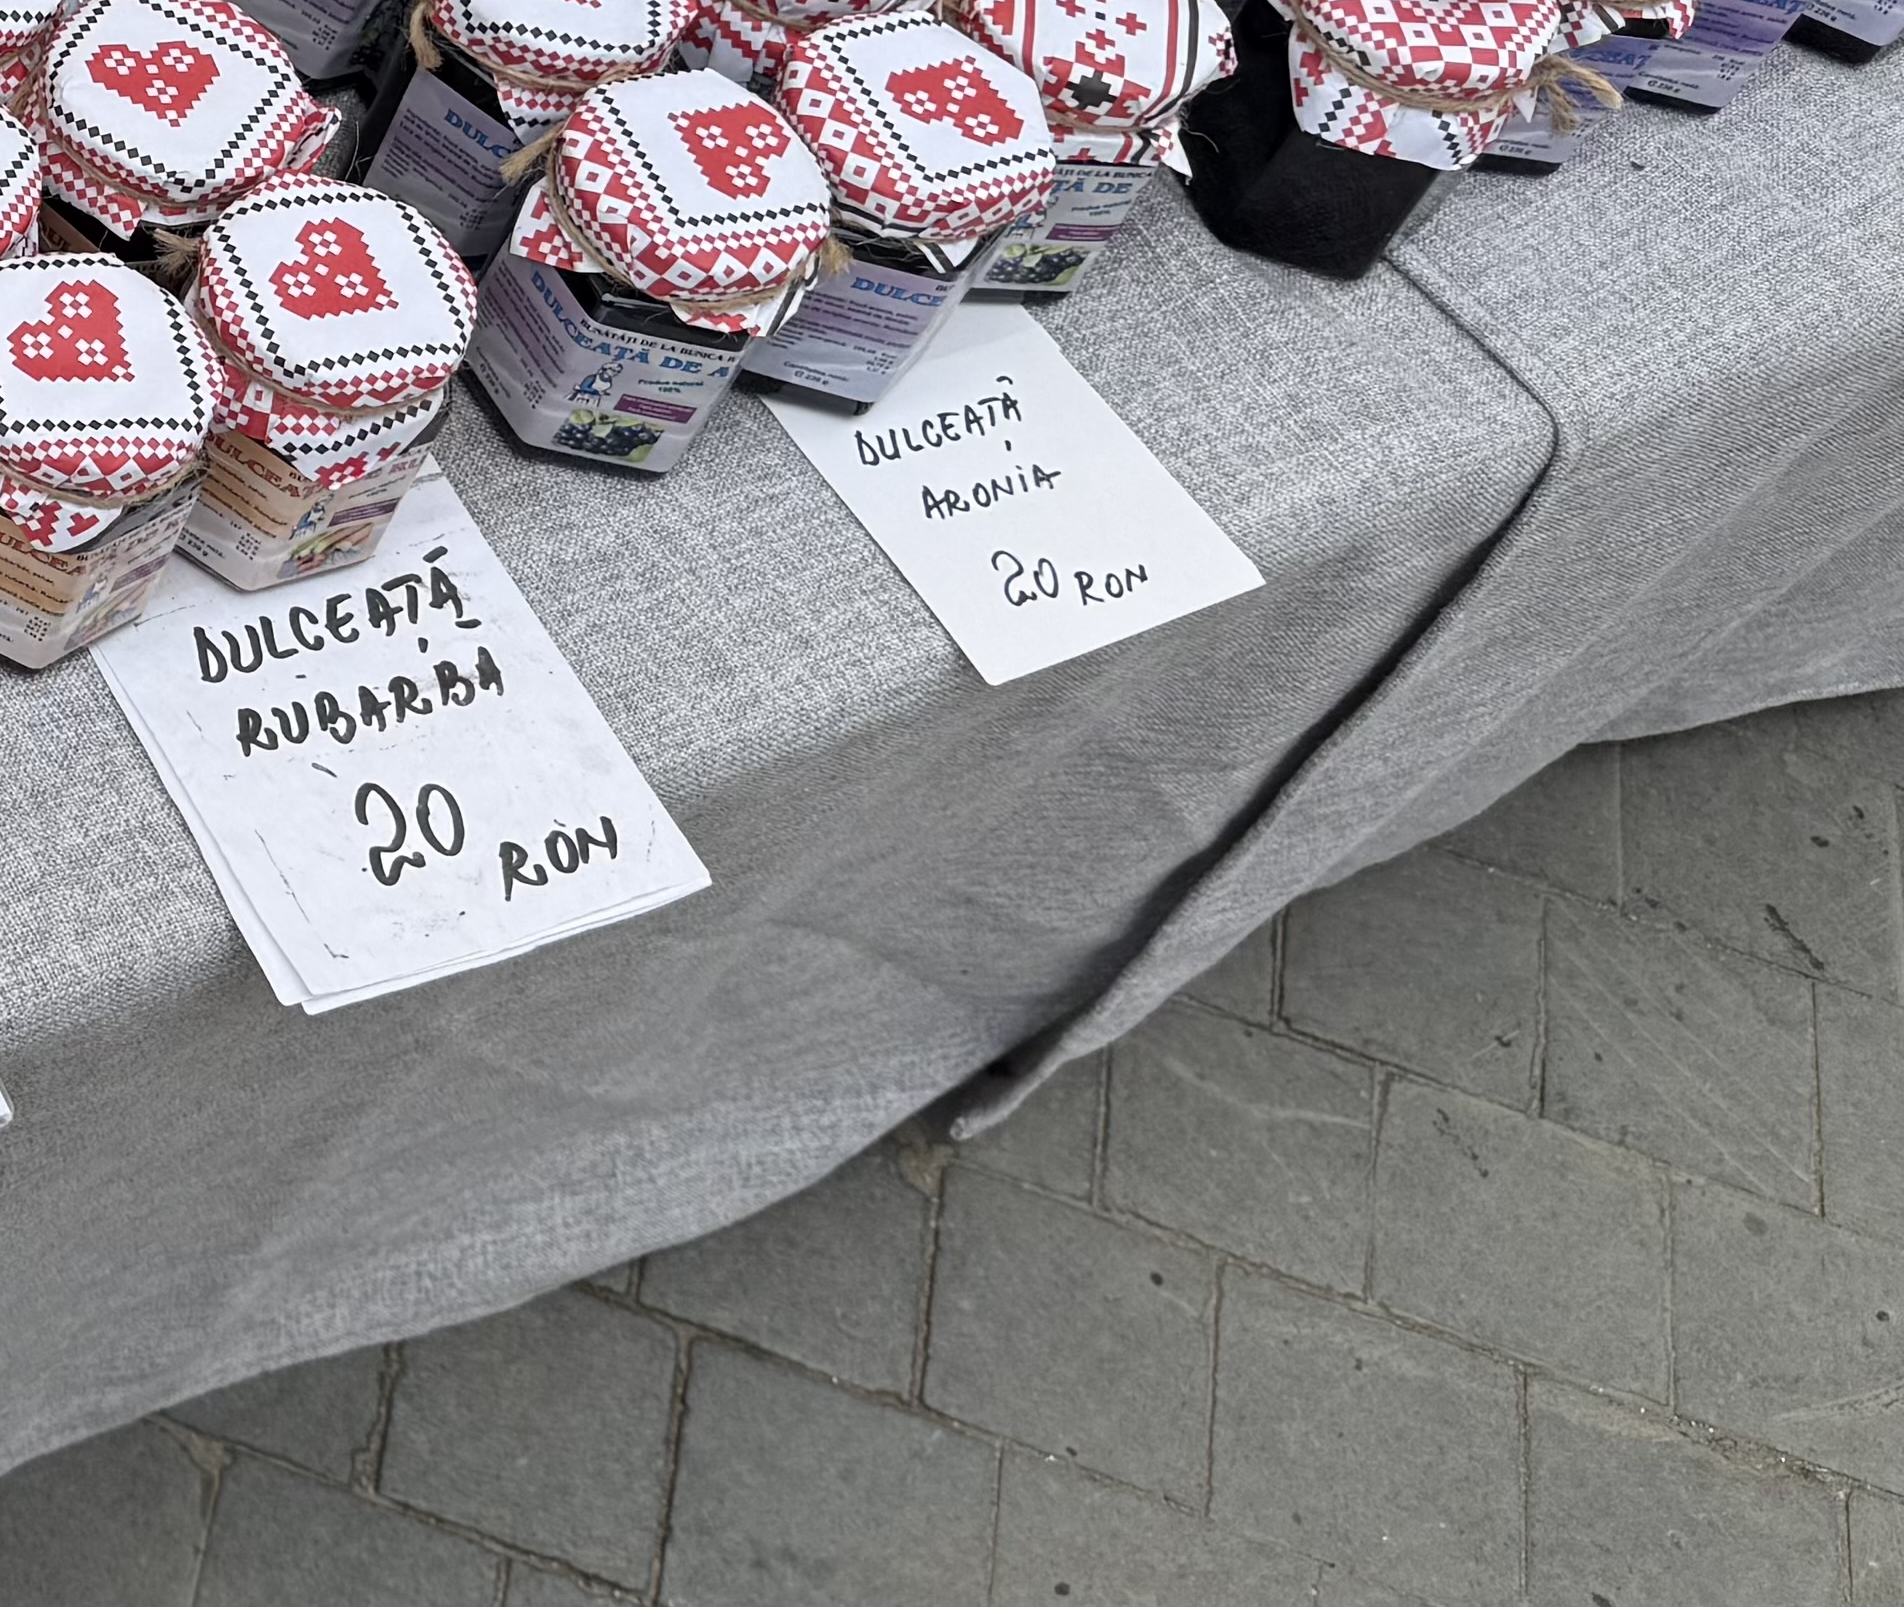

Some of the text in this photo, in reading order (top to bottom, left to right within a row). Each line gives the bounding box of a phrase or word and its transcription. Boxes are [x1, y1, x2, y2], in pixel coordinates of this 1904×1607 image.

[990, 549, 1149, 608] 20 RON
[353, 782, 619, 902] 20 RON
